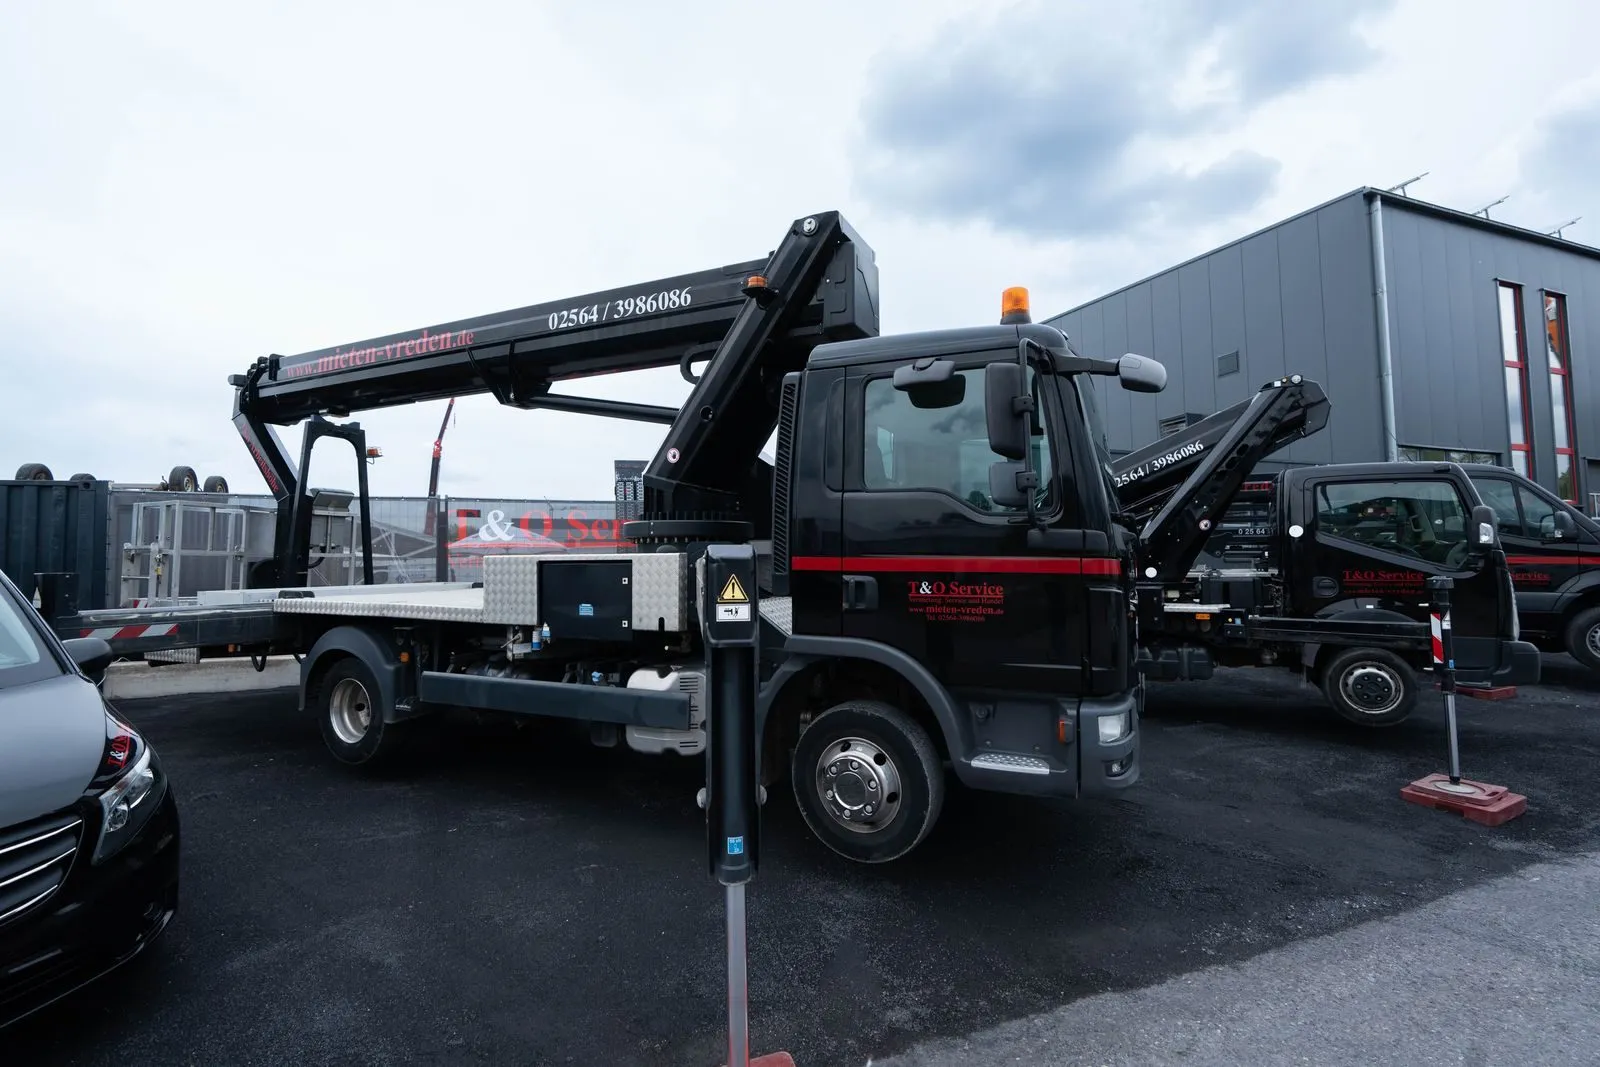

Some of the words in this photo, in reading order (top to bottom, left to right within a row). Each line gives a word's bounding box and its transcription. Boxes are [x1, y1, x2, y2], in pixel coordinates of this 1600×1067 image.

[548, 304, 598, 330] 02564
[602, 301, 610, 321] /
[613, 286, 692, 318] 3986086
[286, 329, 475, 377] www.mieten-vreden.de
[1151, 439, 1204, 471] 3986086
[448, 508, 553, 541] T&O
[908, 580, 946, 595] T&O
[949, 581, 1004, 596] Service
[1343, 569, 1375, 580] T&O
[1377, 570, 1425, 581] Service
[909, 606, 1004, 616] www.mieten-vreden.de
